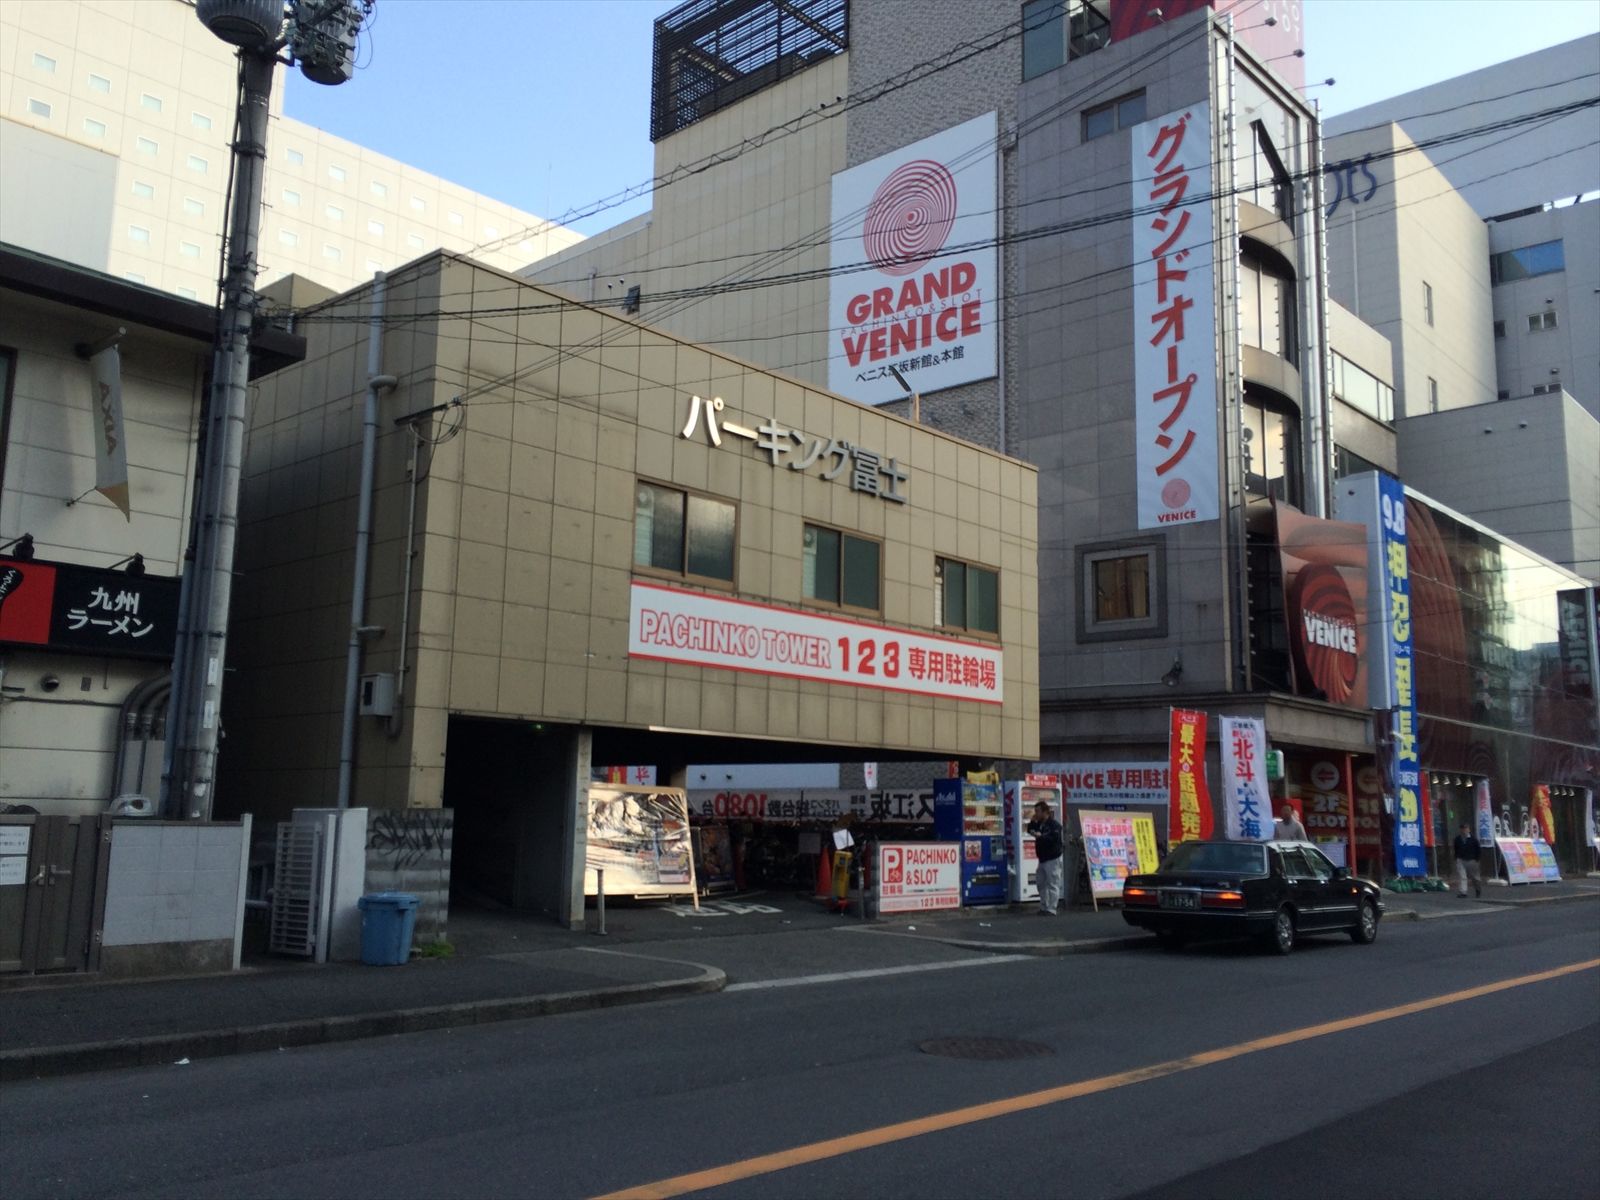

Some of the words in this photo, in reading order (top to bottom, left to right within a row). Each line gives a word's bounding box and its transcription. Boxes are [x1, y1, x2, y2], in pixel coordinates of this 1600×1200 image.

[846, 261, 976, 325] GRAND
[1147, 113, 1196, 477] グランドオープン
[842, 299, 981, 368] VENICE
[681, 396, 909, 505] パーキング富士
[1158, 509, 1196, 523] VENICE
[88, 586, 140, 614] 九州
[67, 608, 154, 638] ラーメン
[1304, 615, 1357, 654] VENICE
[640, 608, 760, 659] PACHINKO
[762, 629, 831, 670] TOWER
[838, 636, 900, 679] 123
[908, 646, 997, 691] 専用駐輪場
[1057, 773, 1105, 790] NICE
[1238, 796, 1261, 839] 大海
[1313, 794, 1341, 813] 2F
[1307, 815, 1347, 829] SLOT
[883, 849, 901, 882] P
[906, 848, 957, 865] PACHINKO
